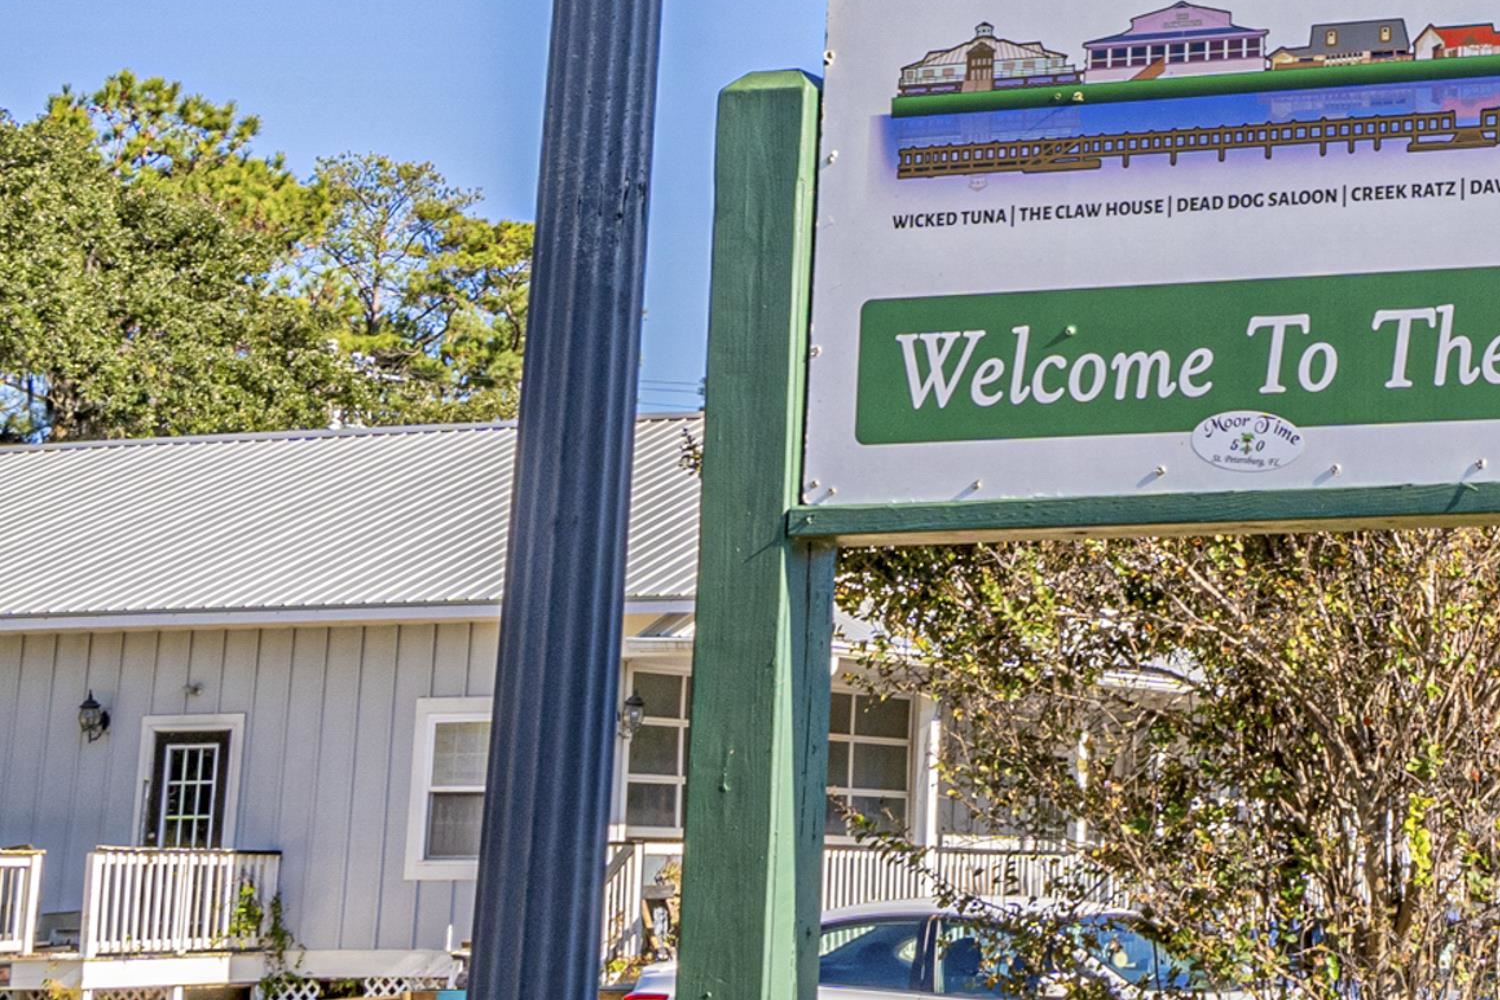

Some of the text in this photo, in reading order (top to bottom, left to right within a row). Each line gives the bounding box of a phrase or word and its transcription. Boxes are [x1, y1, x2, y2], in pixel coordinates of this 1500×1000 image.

[892, 211, 958, 230] WICKED
[960, 208, 1007, 225] TUNA
[1019, 205, 1052, 222] THE
[1055, 203, 1102, 220] CLAW
[1105, 199, 1164, 217] HOUSE
[1176, 195, 1224, 213] DEAD
[1228, 192, 1264, 209] DOG
[1268, 188, 1338, 207] SALOON
[1351, 184, 1407, 202] CREEK
[1411, 181, 1457, 198] RATZ
[896, 325, 1214, 410] Welcome
[1246, 314, 1338, 394] To
[1204, 415, 1300, 445] Moor Time
